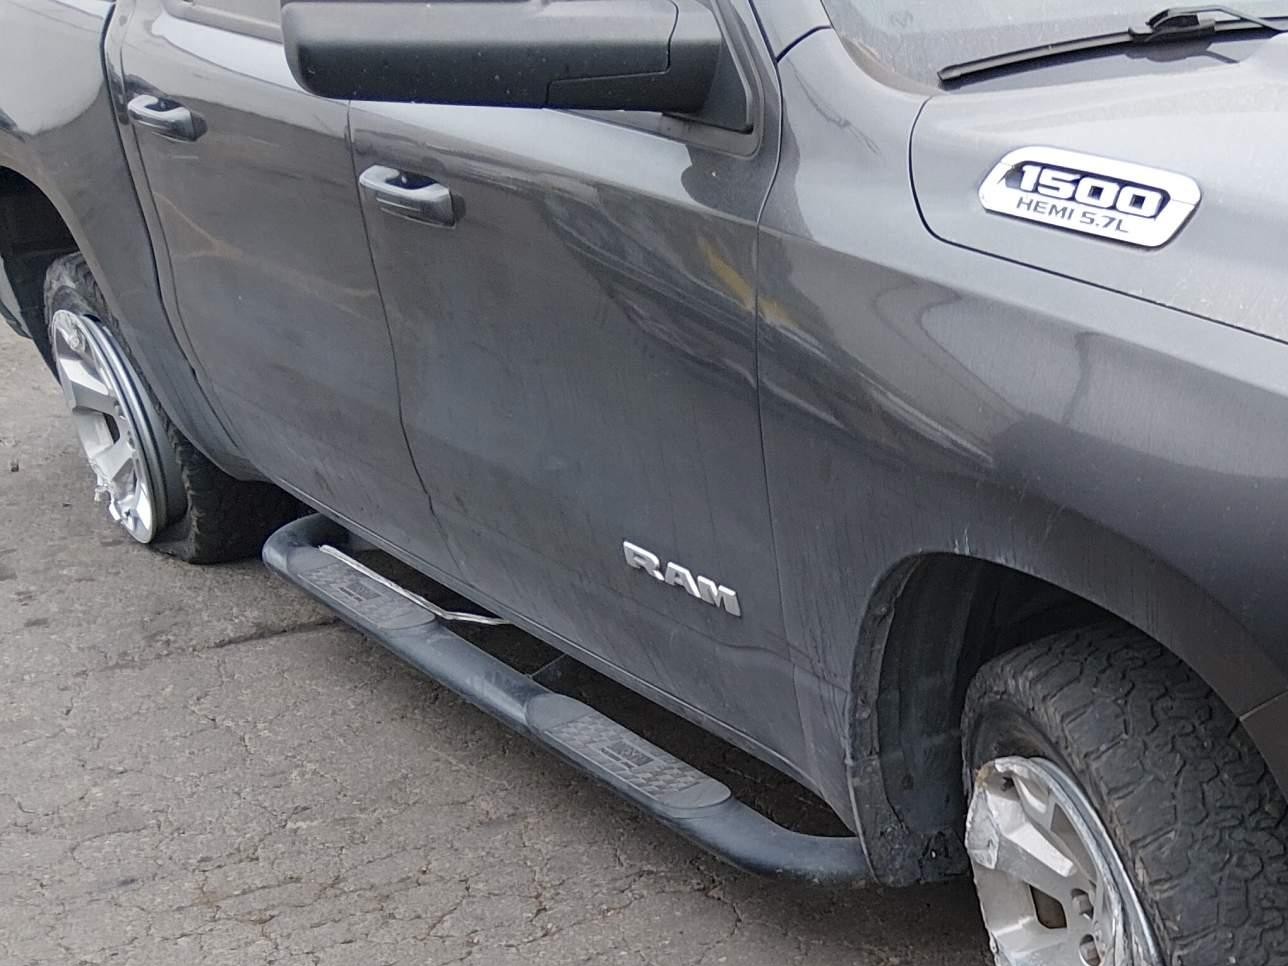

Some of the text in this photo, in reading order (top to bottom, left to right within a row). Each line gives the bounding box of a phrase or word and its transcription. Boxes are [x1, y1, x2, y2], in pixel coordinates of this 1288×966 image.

[1016, 196, 1129, 234] HEMI 5.7L
[1019, 164, 1163, 219] 1500
[622, 540, 742, 617] RAM
